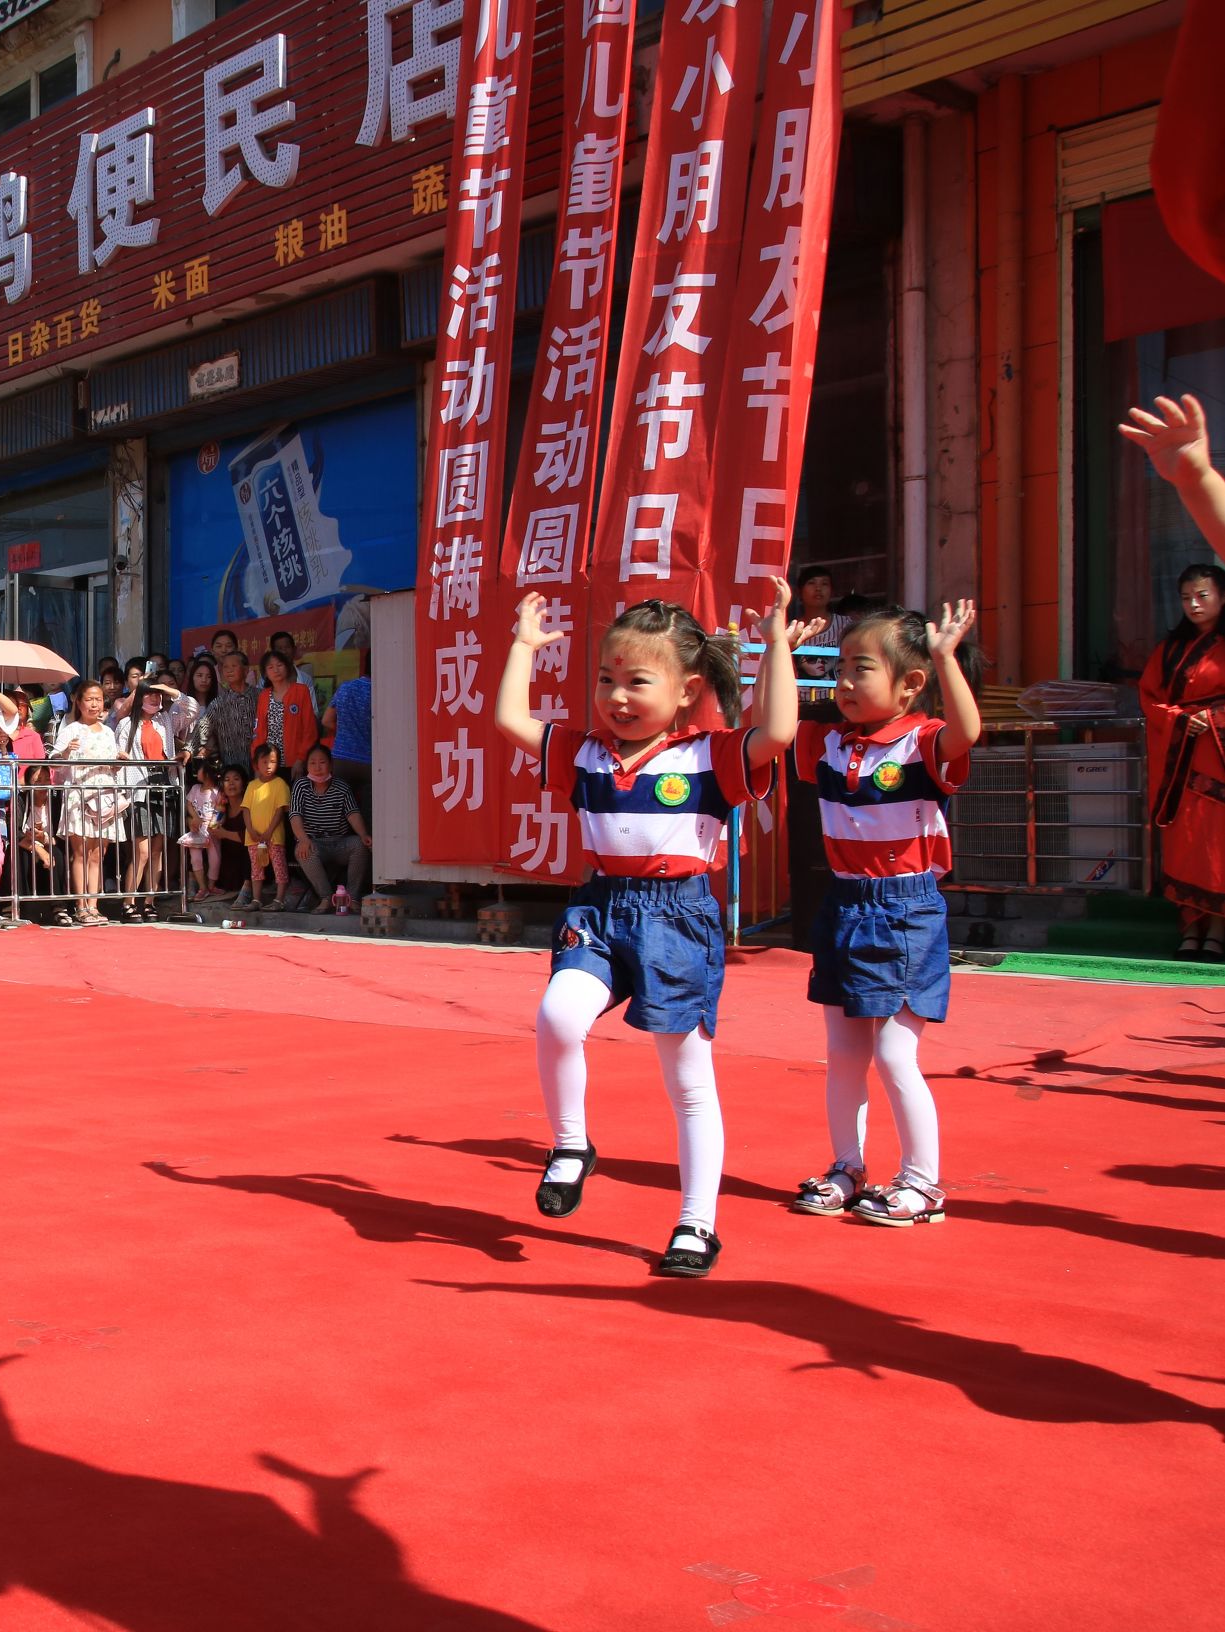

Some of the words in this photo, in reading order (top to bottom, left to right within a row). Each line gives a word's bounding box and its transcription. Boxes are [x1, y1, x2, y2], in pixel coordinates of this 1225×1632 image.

[7, 298, 103, 367] 日杂百货
[151, 255, 211, 311] 米面
[274, 203, 349, 266] 粮油
[428, 0, 522, 812] 儿童节活动圆满成功
[616, 0, 736, 617] 小朋友节日
[259, 477, 304, 588] 六个核桃
